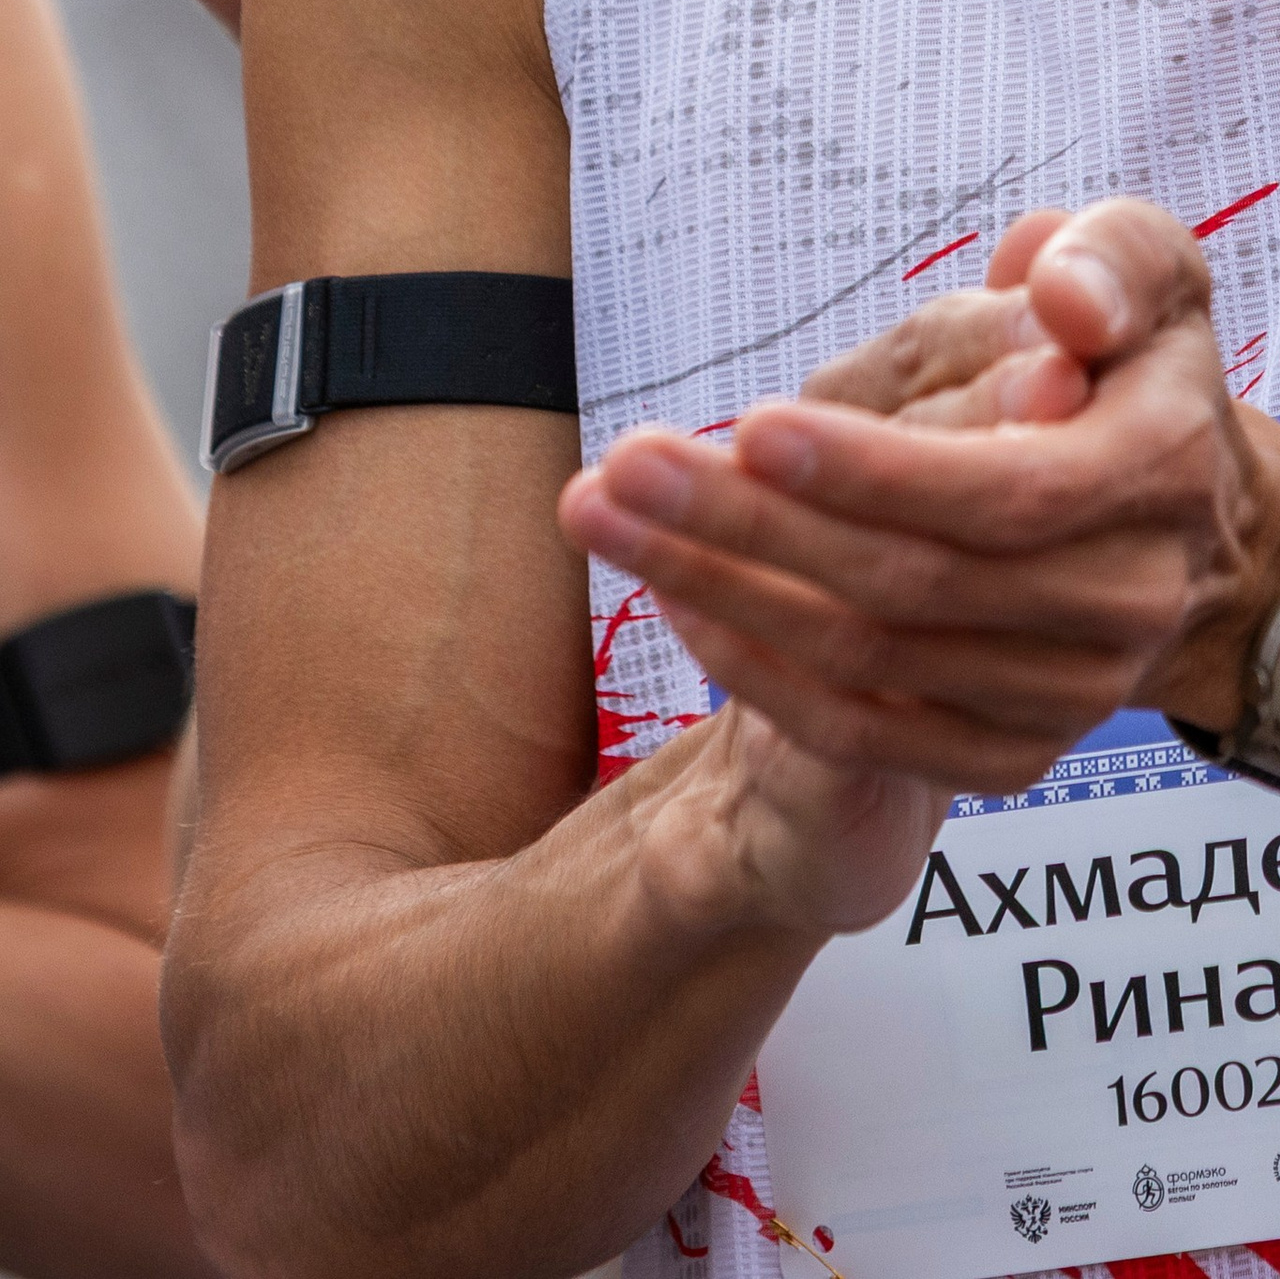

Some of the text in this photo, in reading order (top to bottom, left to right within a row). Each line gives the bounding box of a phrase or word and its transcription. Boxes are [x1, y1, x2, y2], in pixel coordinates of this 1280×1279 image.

[1190, 1184, 1201, 1192] ПО
[1201, 1178, 1239, 1190] ЗОЛОТОМУ
[1058, 1201, 1097, 1213] МИНСПОРТ
[1060, 1213, 1090, 1224] РОССИИ
